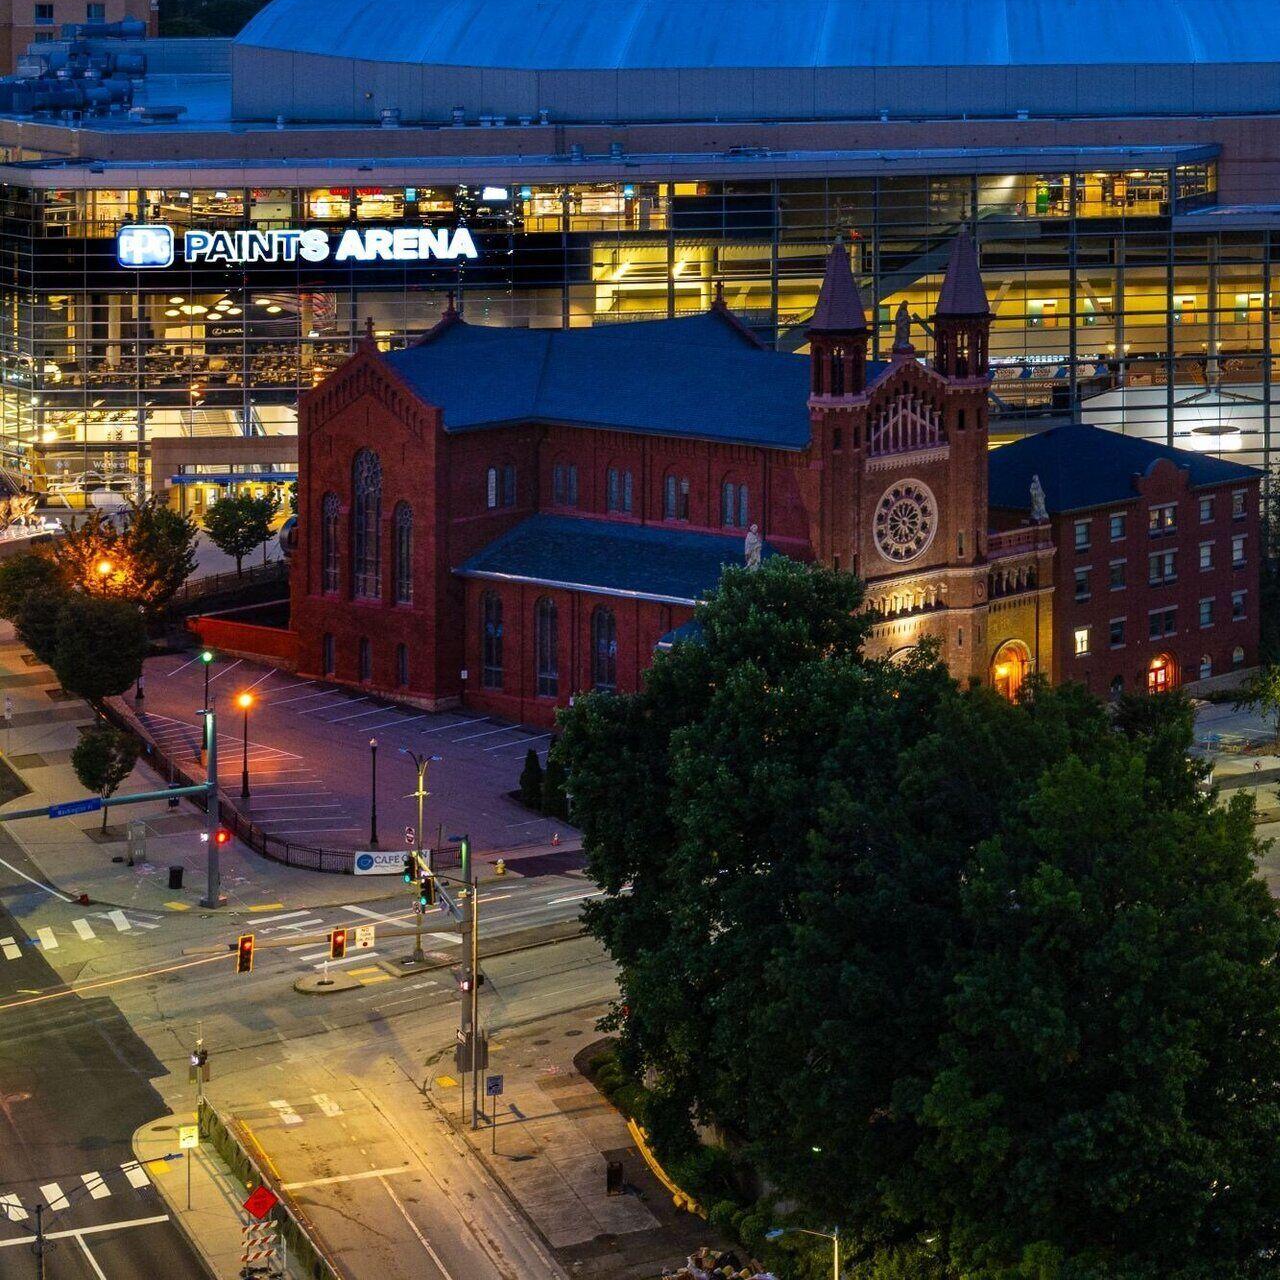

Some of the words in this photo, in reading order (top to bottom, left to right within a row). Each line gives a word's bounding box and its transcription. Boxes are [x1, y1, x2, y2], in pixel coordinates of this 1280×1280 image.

[119, 230, 171, 265] PPG
[184, 229, 330, 262] PAINTS
[335, 228, 479, 261] ARENA
